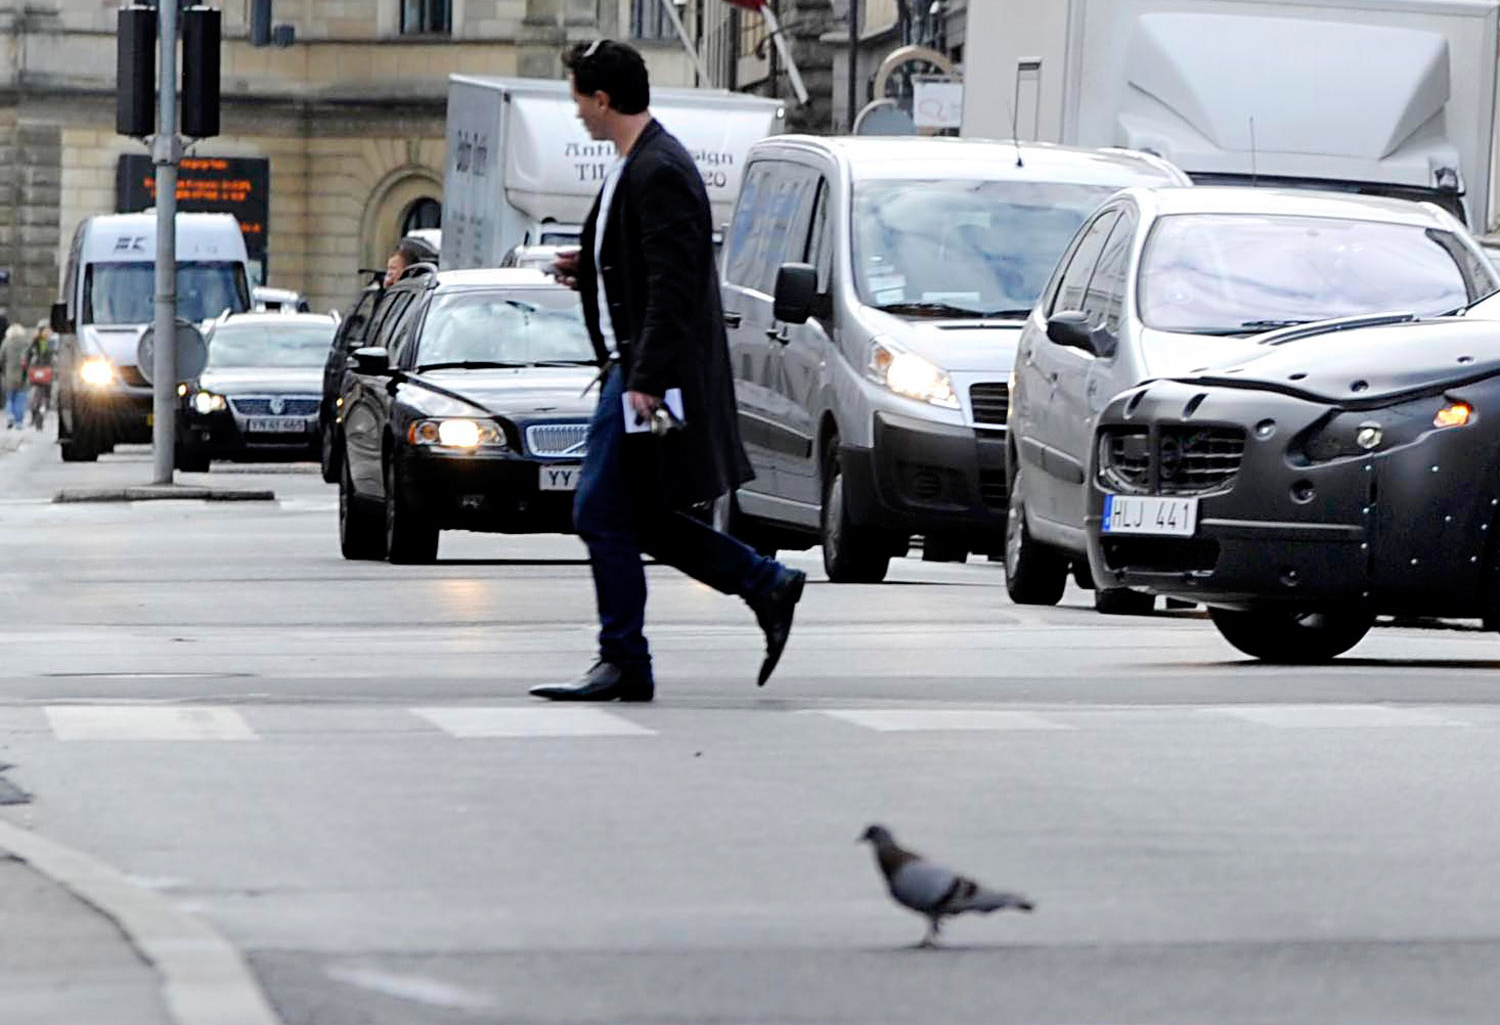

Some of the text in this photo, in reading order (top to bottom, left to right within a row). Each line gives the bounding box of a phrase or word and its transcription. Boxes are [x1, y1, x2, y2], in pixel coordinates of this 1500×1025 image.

[549, 470, 572, 487] YY
[1113, 500, 1188, 530] HLJ 441
